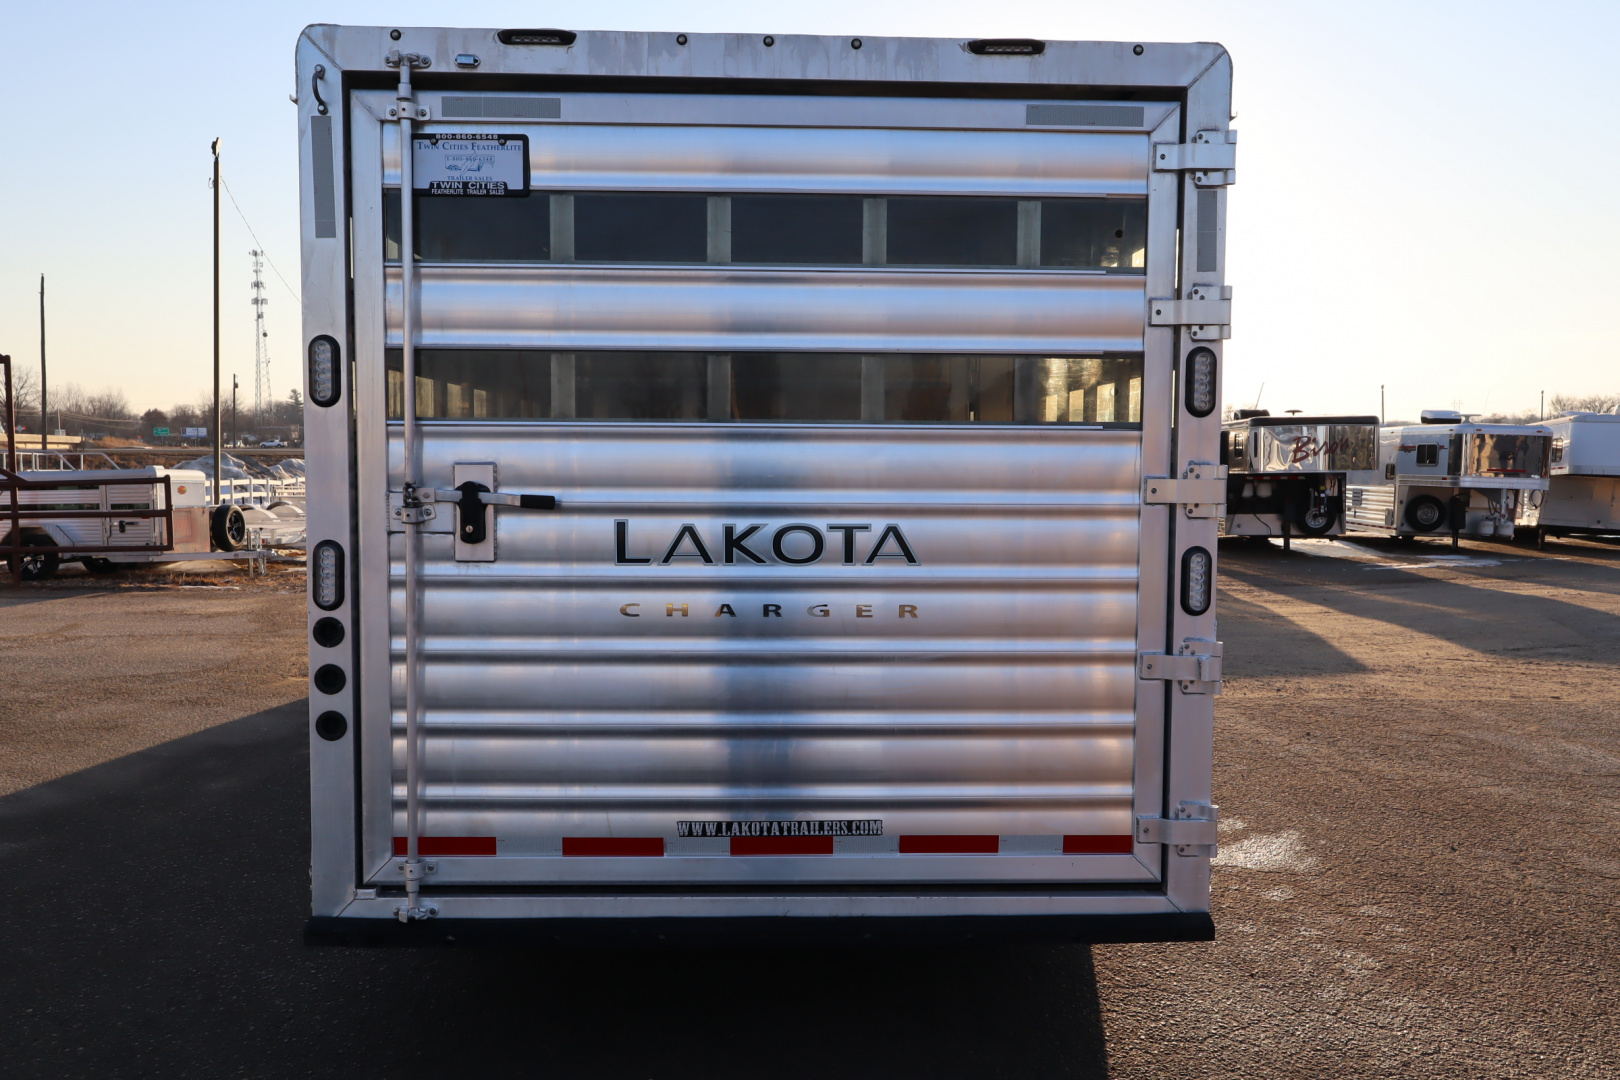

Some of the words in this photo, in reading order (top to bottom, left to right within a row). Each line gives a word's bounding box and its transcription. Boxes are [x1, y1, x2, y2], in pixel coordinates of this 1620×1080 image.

[431, 181, 463, 189] TWIN
[468, 181, 505, 189] CITIES
[1292, 436, 1350, 463] Bison
[613, 518, 922, 567] LAKOTA
[619, 602, 919, 619] CHARGER
[677, 820, 883, 837] WWW.LAKOTATRAILERS.COM
